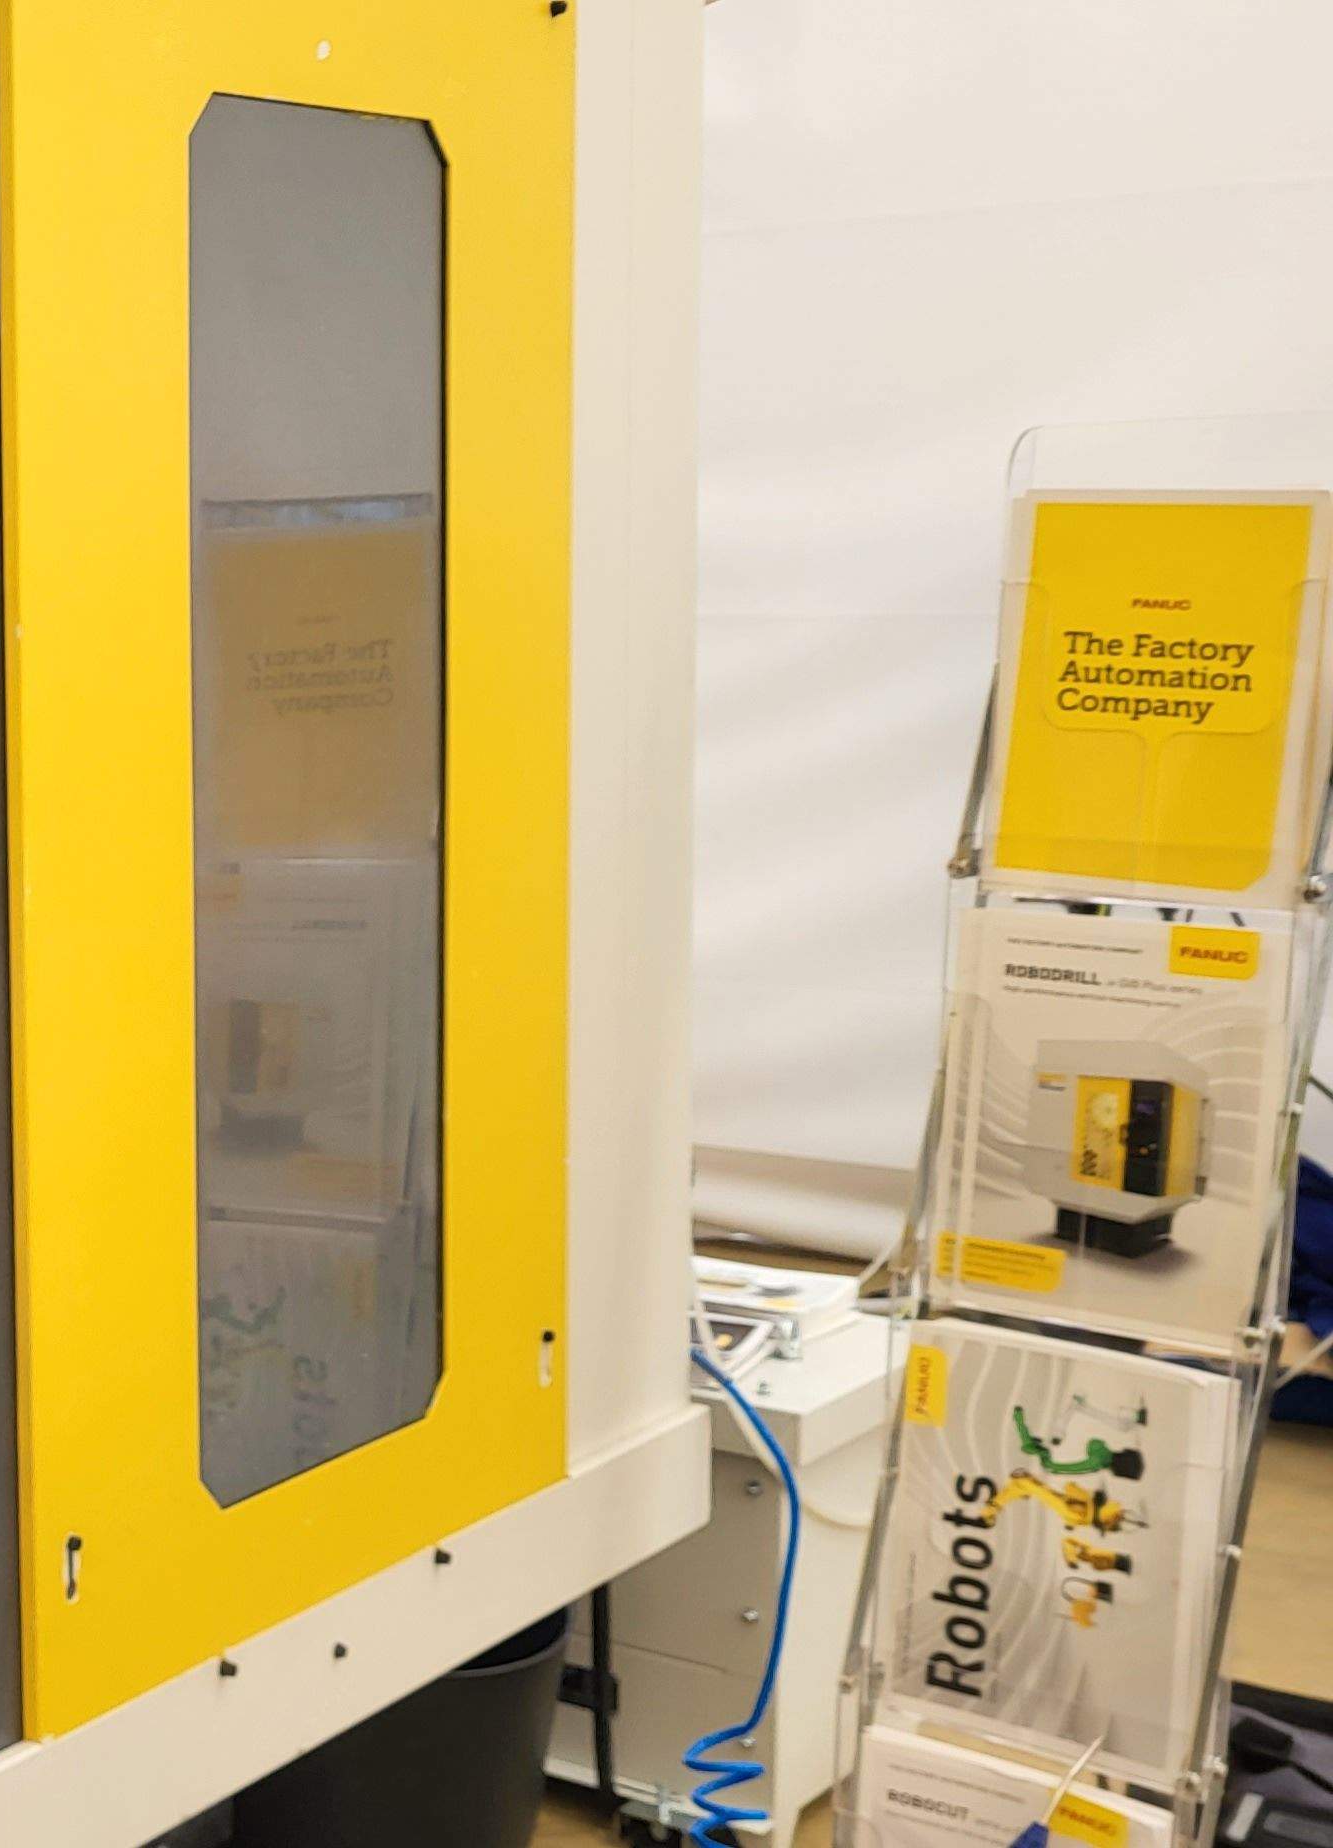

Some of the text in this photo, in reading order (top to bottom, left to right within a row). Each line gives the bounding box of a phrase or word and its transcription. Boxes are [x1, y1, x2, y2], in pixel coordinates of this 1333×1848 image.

[1132, 598, 1191, 611] FANUC
[1064, 631, 1254, 667] The Factory
[1058, 660, 1252, 692] Automation
[1057, 687, 1214, 724] Company
[1179, 945, 1249, 964] FANUC
[1004, 963, 1102, 986] ROBODRILL
[925, 1474, 997, 1697] Robots
[888, 1787, 969, 1821] ROBOCUT
